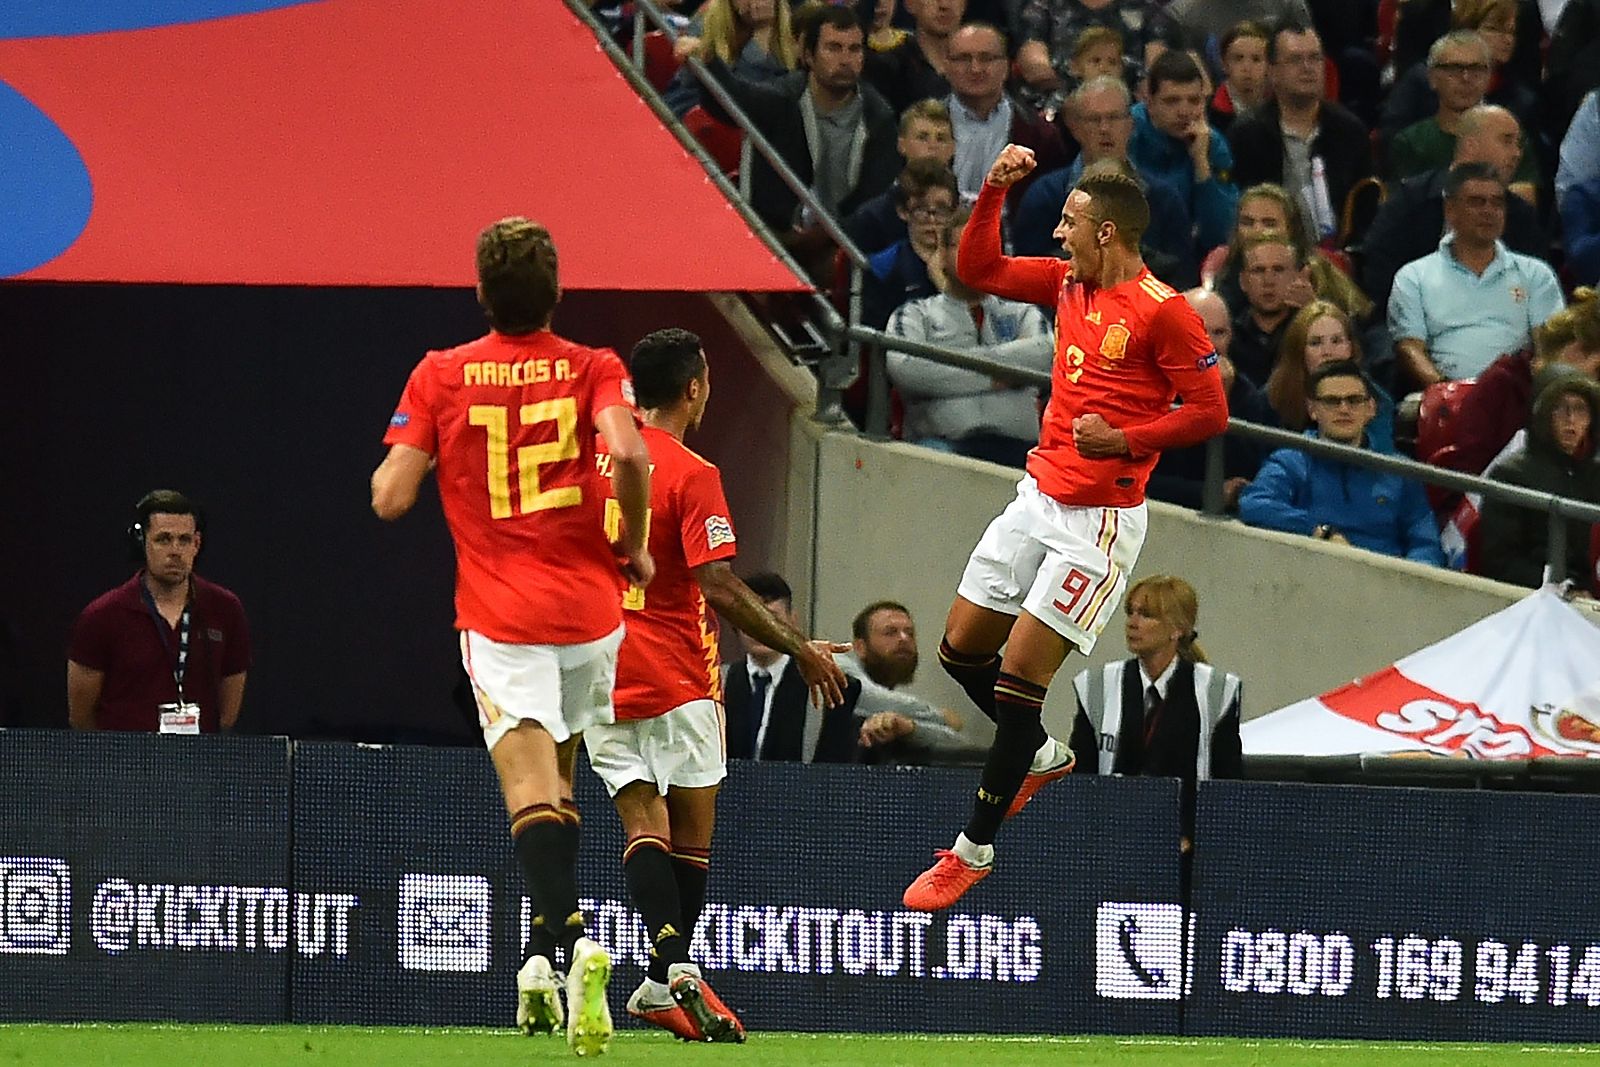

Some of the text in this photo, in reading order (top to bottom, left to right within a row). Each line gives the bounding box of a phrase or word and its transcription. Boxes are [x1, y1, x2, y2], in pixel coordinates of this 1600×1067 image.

[464, 360, 551, 387] MARCOS
[468, 397, 583, 519] 12
[1053, 568, 1091, 614] 9
[90, 877, 358, 957] @KICKITOUT
[1220, 926, 1355, 997] 0800
[1371, 932, 1463, 1001] 169
